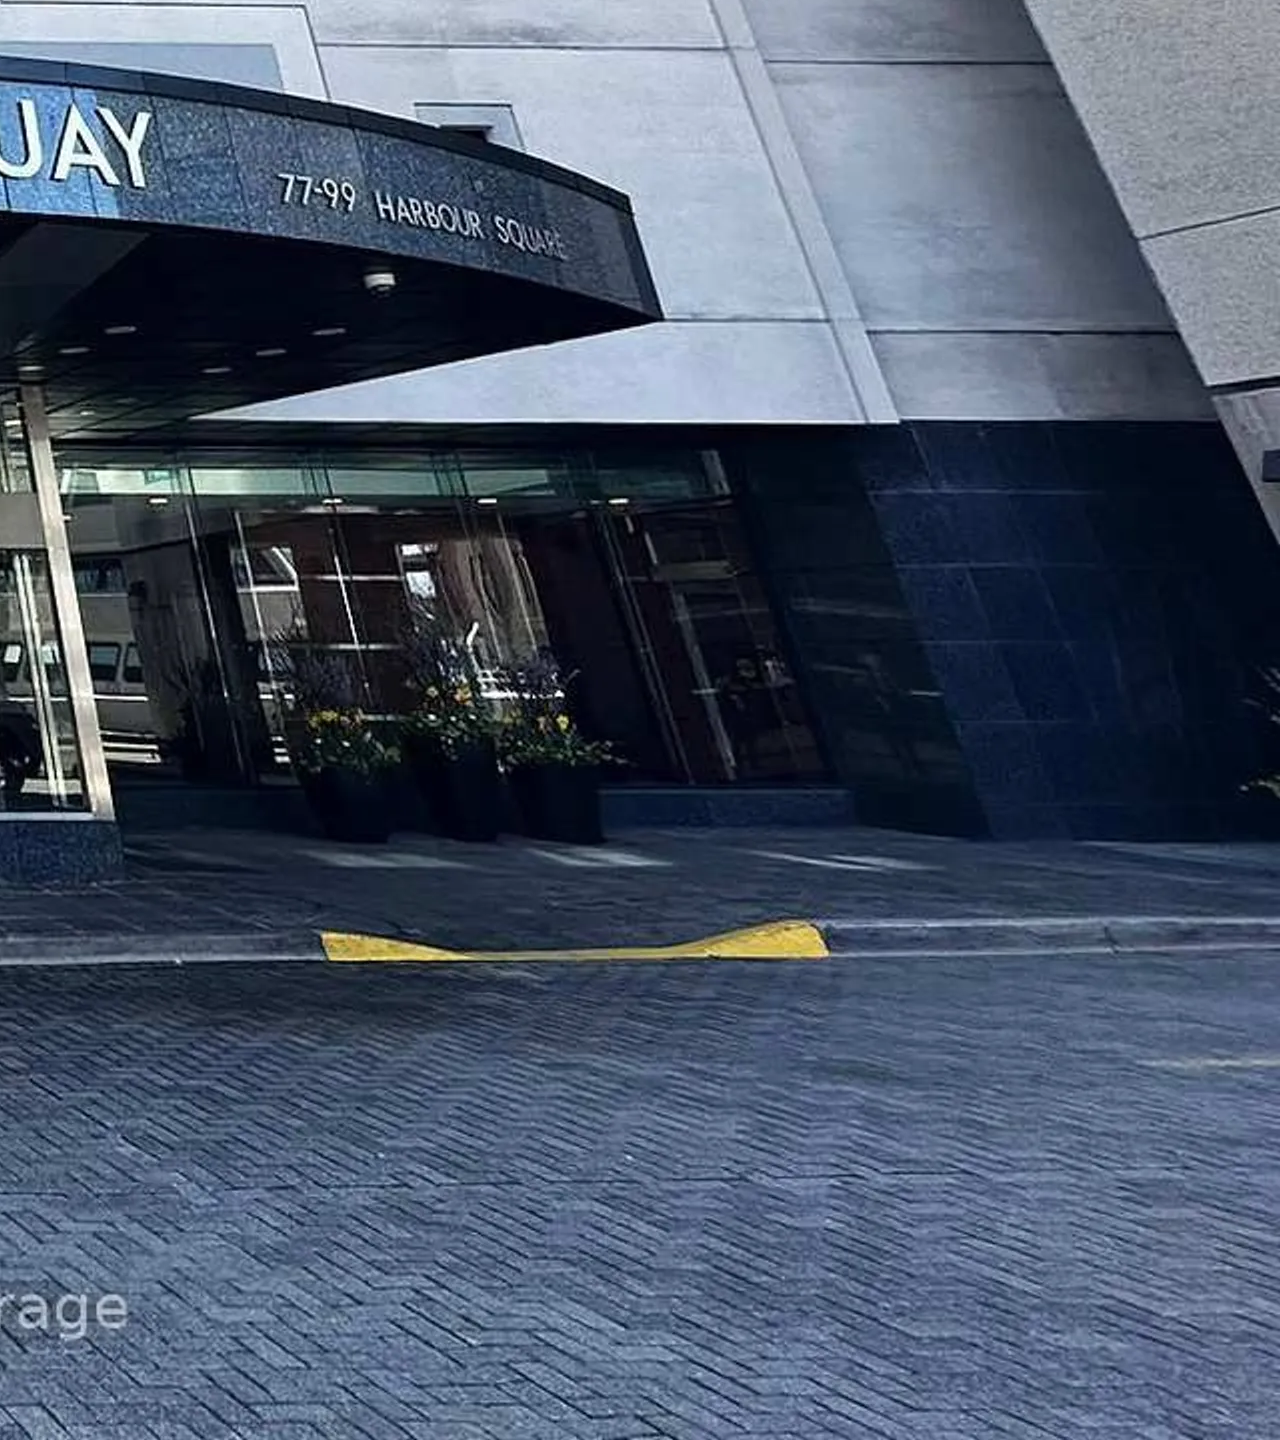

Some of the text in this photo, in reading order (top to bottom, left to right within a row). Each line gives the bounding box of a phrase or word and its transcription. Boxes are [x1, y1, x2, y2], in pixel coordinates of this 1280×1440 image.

[277, 173, 568, 260] 77-99 HARBOUR SQUARE
